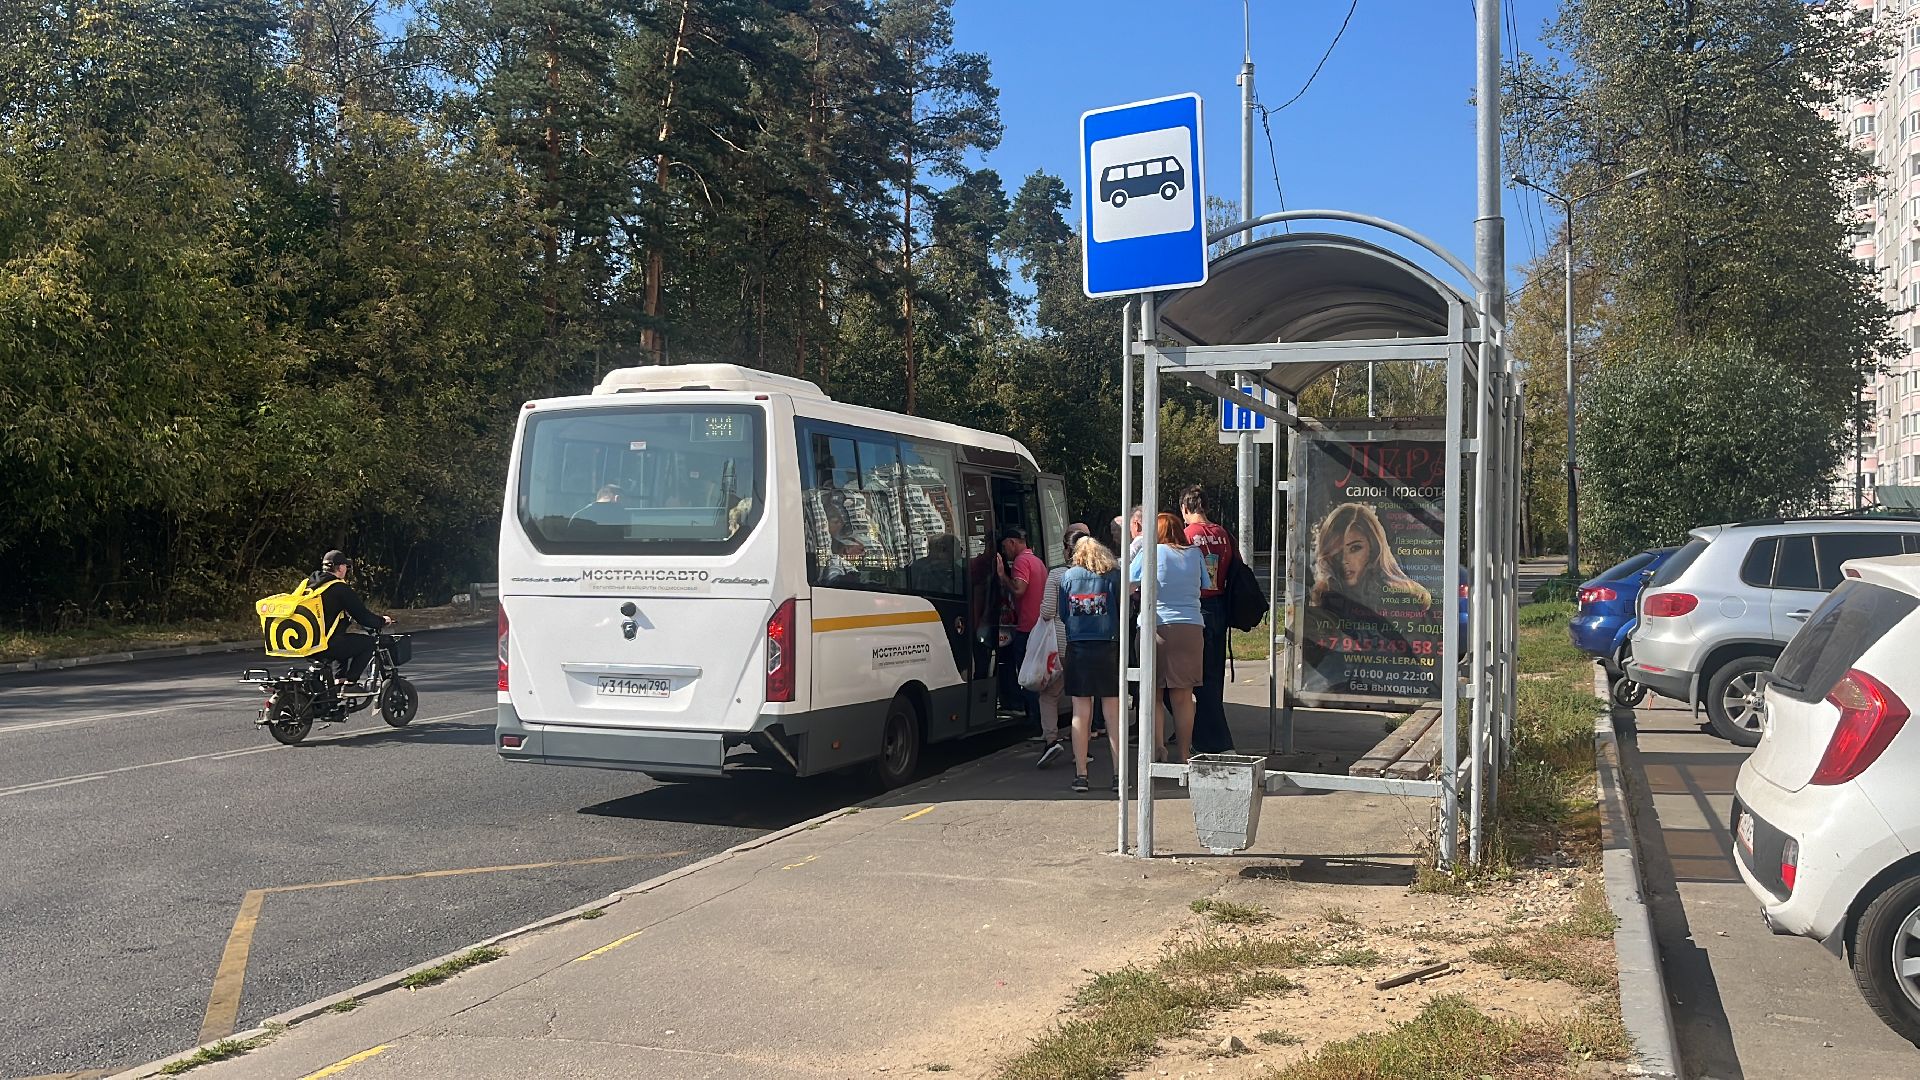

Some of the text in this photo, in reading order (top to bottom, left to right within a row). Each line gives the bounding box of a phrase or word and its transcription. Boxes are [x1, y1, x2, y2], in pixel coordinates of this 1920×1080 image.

[1346, 485, 1387, 498] салон
[1397, 546, 1411, 556] без
[1412, 547, 1432, 557] боли
[582, 569, 709, 581] МОСТРАНСАВТО
[1316, 620, 1332, 630] ул.
[1407, 621, 1415, 633] 5
[872, 643, 930, 659] МОСТРАНСАВТО
[1317, 636, 1339, 650] +7
[1412, 640, 1433, 655] 58
[1343, 654, 1435, 667] WWW.SK-LERA.RU
[1353, 668, 1384, 679] 10:00
[1386, 672, 1400, 681] до
[1402, 670, 1434, 682] 22:00
[648, 680, 667, 692] 790
[1349, 681, 1429, 695] без выходных
